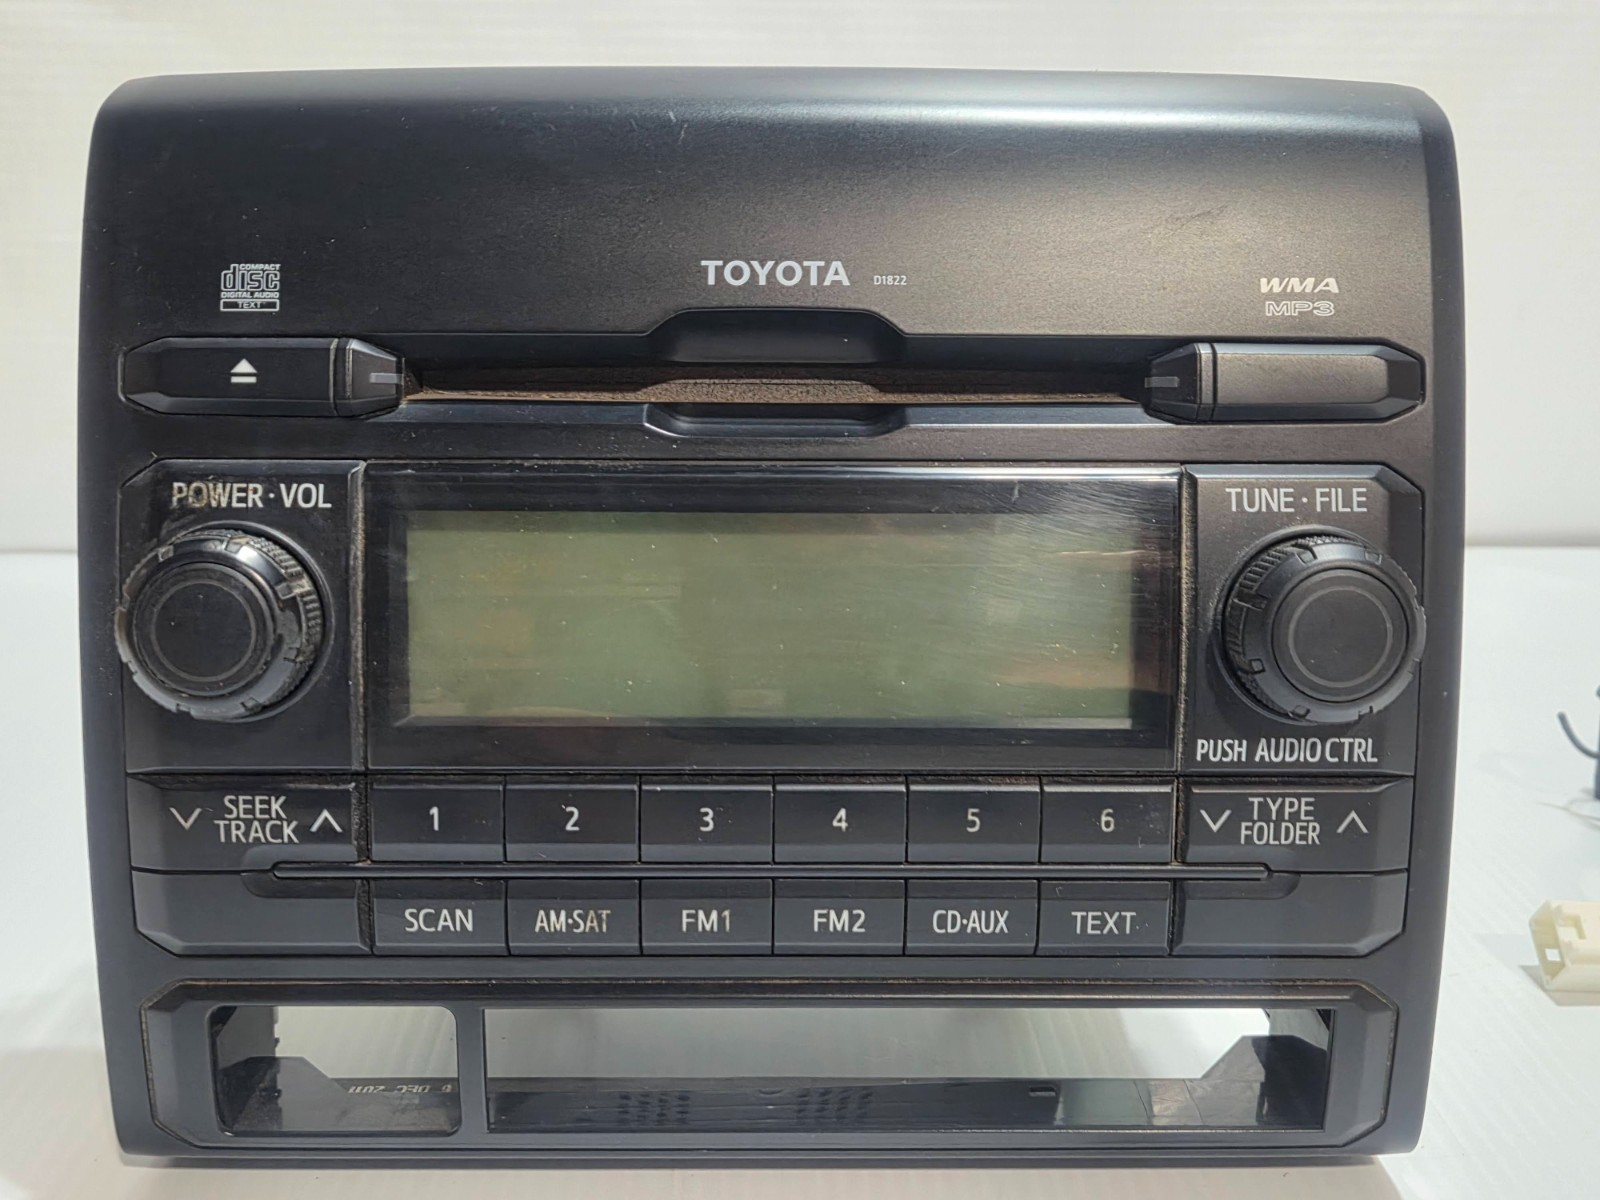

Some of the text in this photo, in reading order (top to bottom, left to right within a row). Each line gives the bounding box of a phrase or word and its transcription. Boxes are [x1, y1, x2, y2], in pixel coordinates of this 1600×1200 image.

[221, 263, 281, 291] disc
[239, 263, 281, 271] COMPACT
[700, 260, 850, 286] TOYOTA
[873, 275, 907, 286] D1822
[1260, 277, 1339, 294] WMA
[220, 291, 280, 299] DIGITAL AUDIO
[237, 300, 262, 309] TEXT
[1264, 300, 1335, 317] MP3
[1196, 737, 1379, 763] PUSH AUDIO CTRL
[223, 795, 287, 819] SEEK
[428, 805, 440, 832] 1
[564, 806, 580, 832] 2
[1248, 797, 1316, 821] TYPE
[699, 807, 715, 832] 3
[831, 807, 849, 832] 4
[965, 808, 981, 832] 5
[1100, 808, 1116, 833] 6
[213, 820, 300, 844] TRACK
[1240, 821, 1321, 845] FOLDER
[403, 908, 474, 933] SCAN
[681, 909, 732, 933] FM1
[812, 909, 866, 933] FM2
[1071, 911, 1136, 935] TEXT
